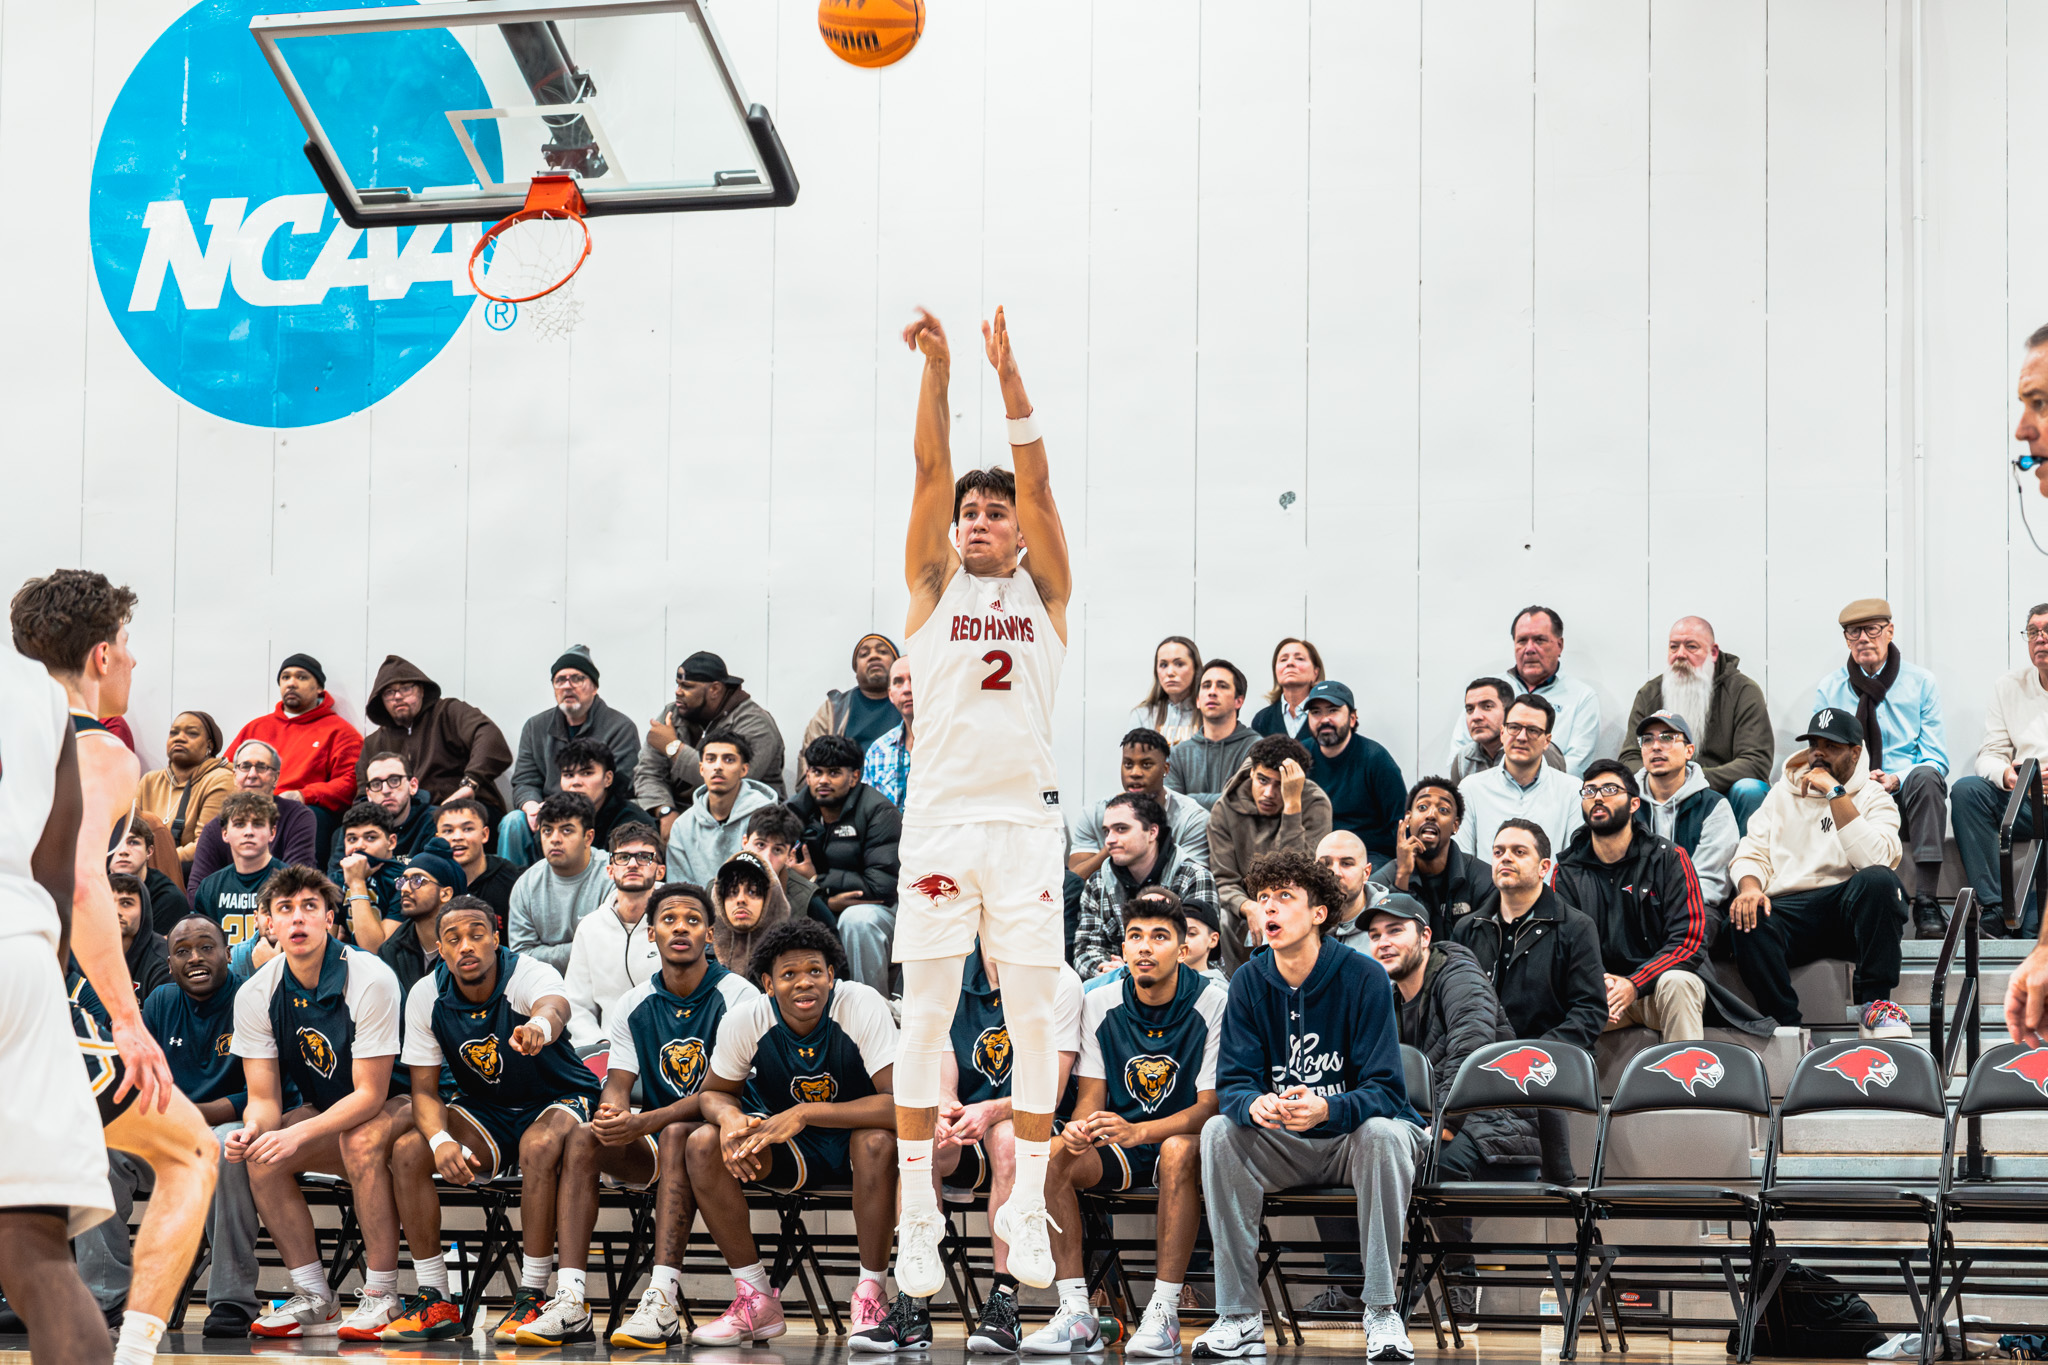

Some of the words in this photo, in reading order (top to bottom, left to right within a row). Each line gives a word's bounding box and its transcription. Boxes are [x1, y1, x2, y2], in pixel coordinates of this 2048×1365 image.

[128, 184, 483, 312] NCAA
[950, 615, 982, 642] RED
[984, 615, 1035, 643] HAWKS
[981, 649, 1013, 691] 2
[1271, 1032, 1344, 1084] Lions
